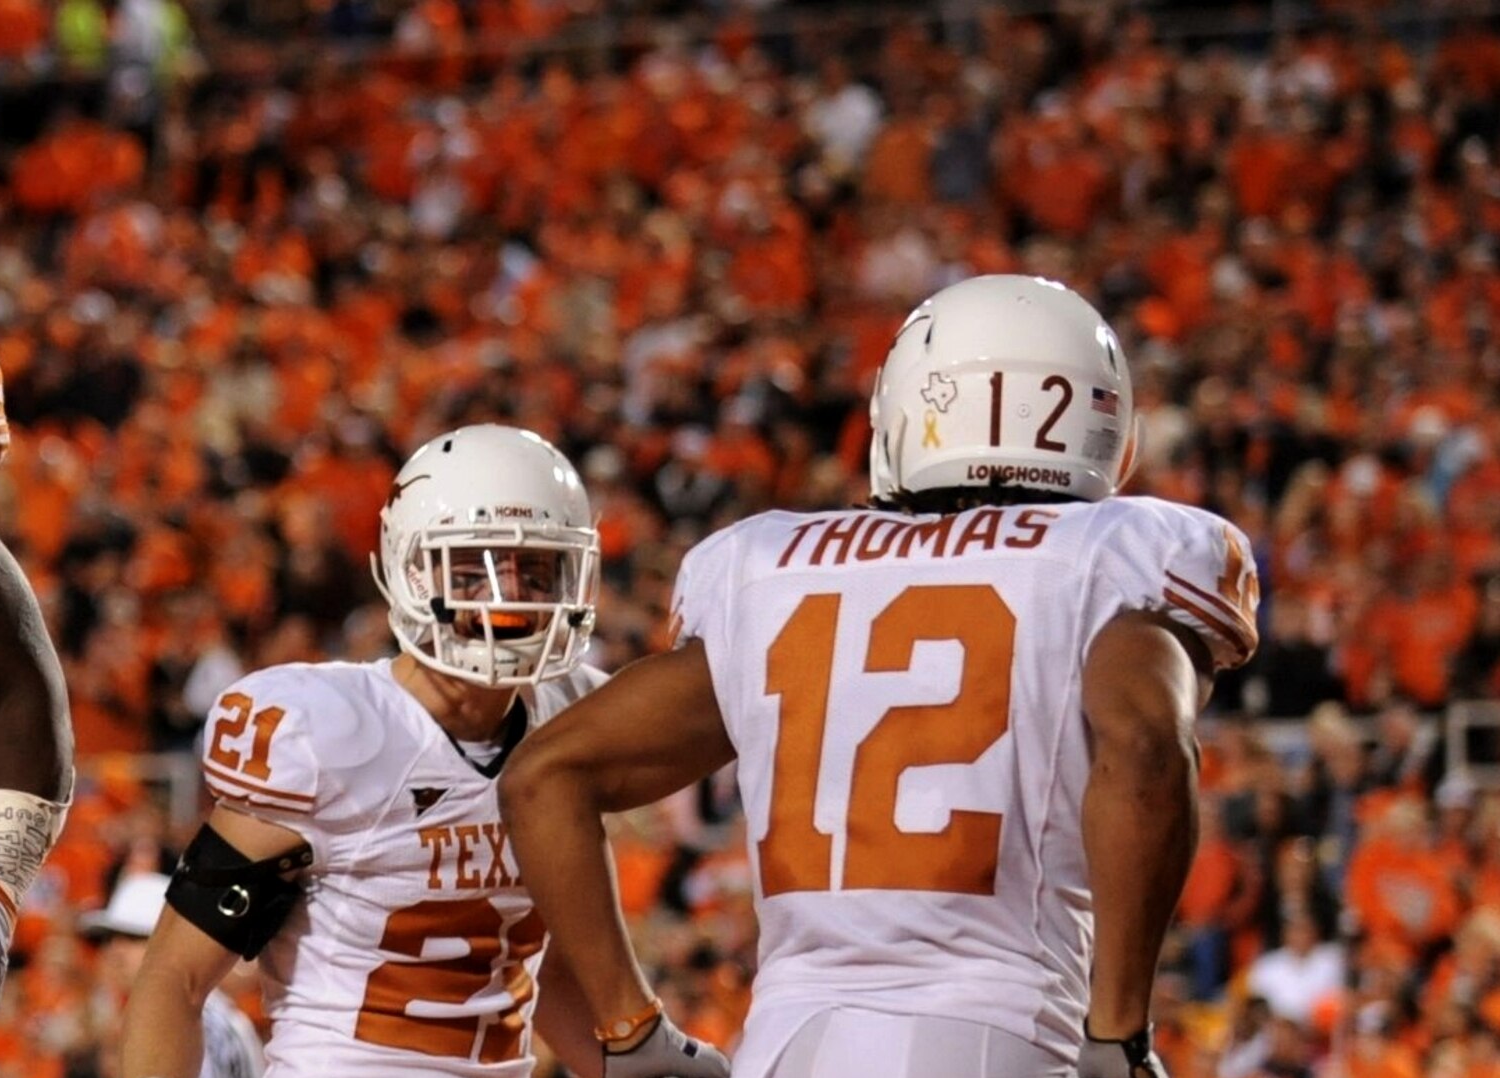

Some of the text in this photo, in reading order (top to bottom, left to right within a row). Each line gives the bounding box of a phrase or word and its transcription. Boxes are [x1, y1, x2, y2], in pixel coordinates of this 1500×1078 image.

[494, 505, 534, 519] HORNS
[776, 507, 1060, 569] THOMAS
[209, 691, 287, 783] 21
[758, 582, 1018, 899] 12
[418, 822, 524, 890] TEX
